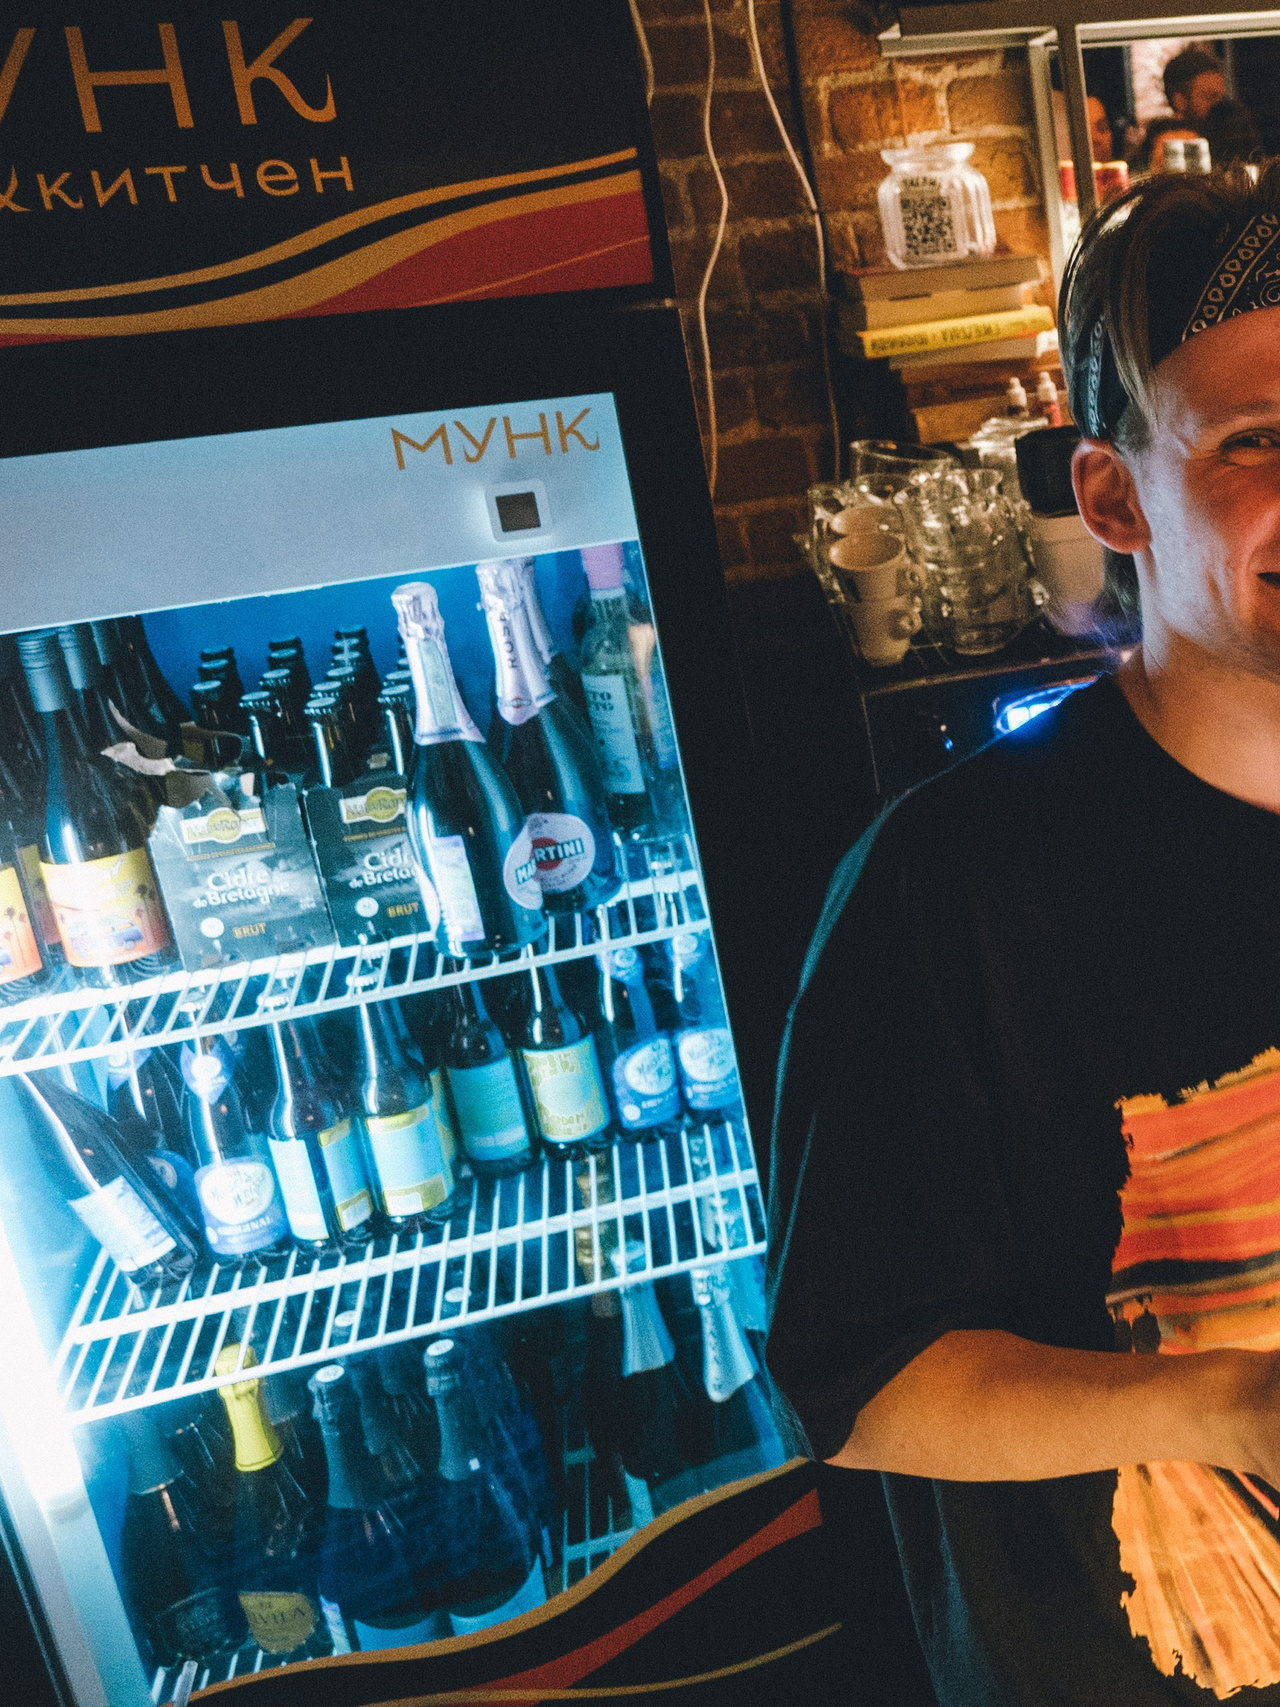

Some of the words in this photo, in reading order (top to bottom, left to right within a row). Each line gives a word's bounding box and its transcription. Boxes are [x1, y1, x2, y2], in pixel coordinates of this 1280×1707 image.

[391, 407, 600, 471] МУНК
[515, 837, 585, 885] MARTINI
[205, 880, 290, 906] Bretagne
[232, 922, 267, 939] BRUT
